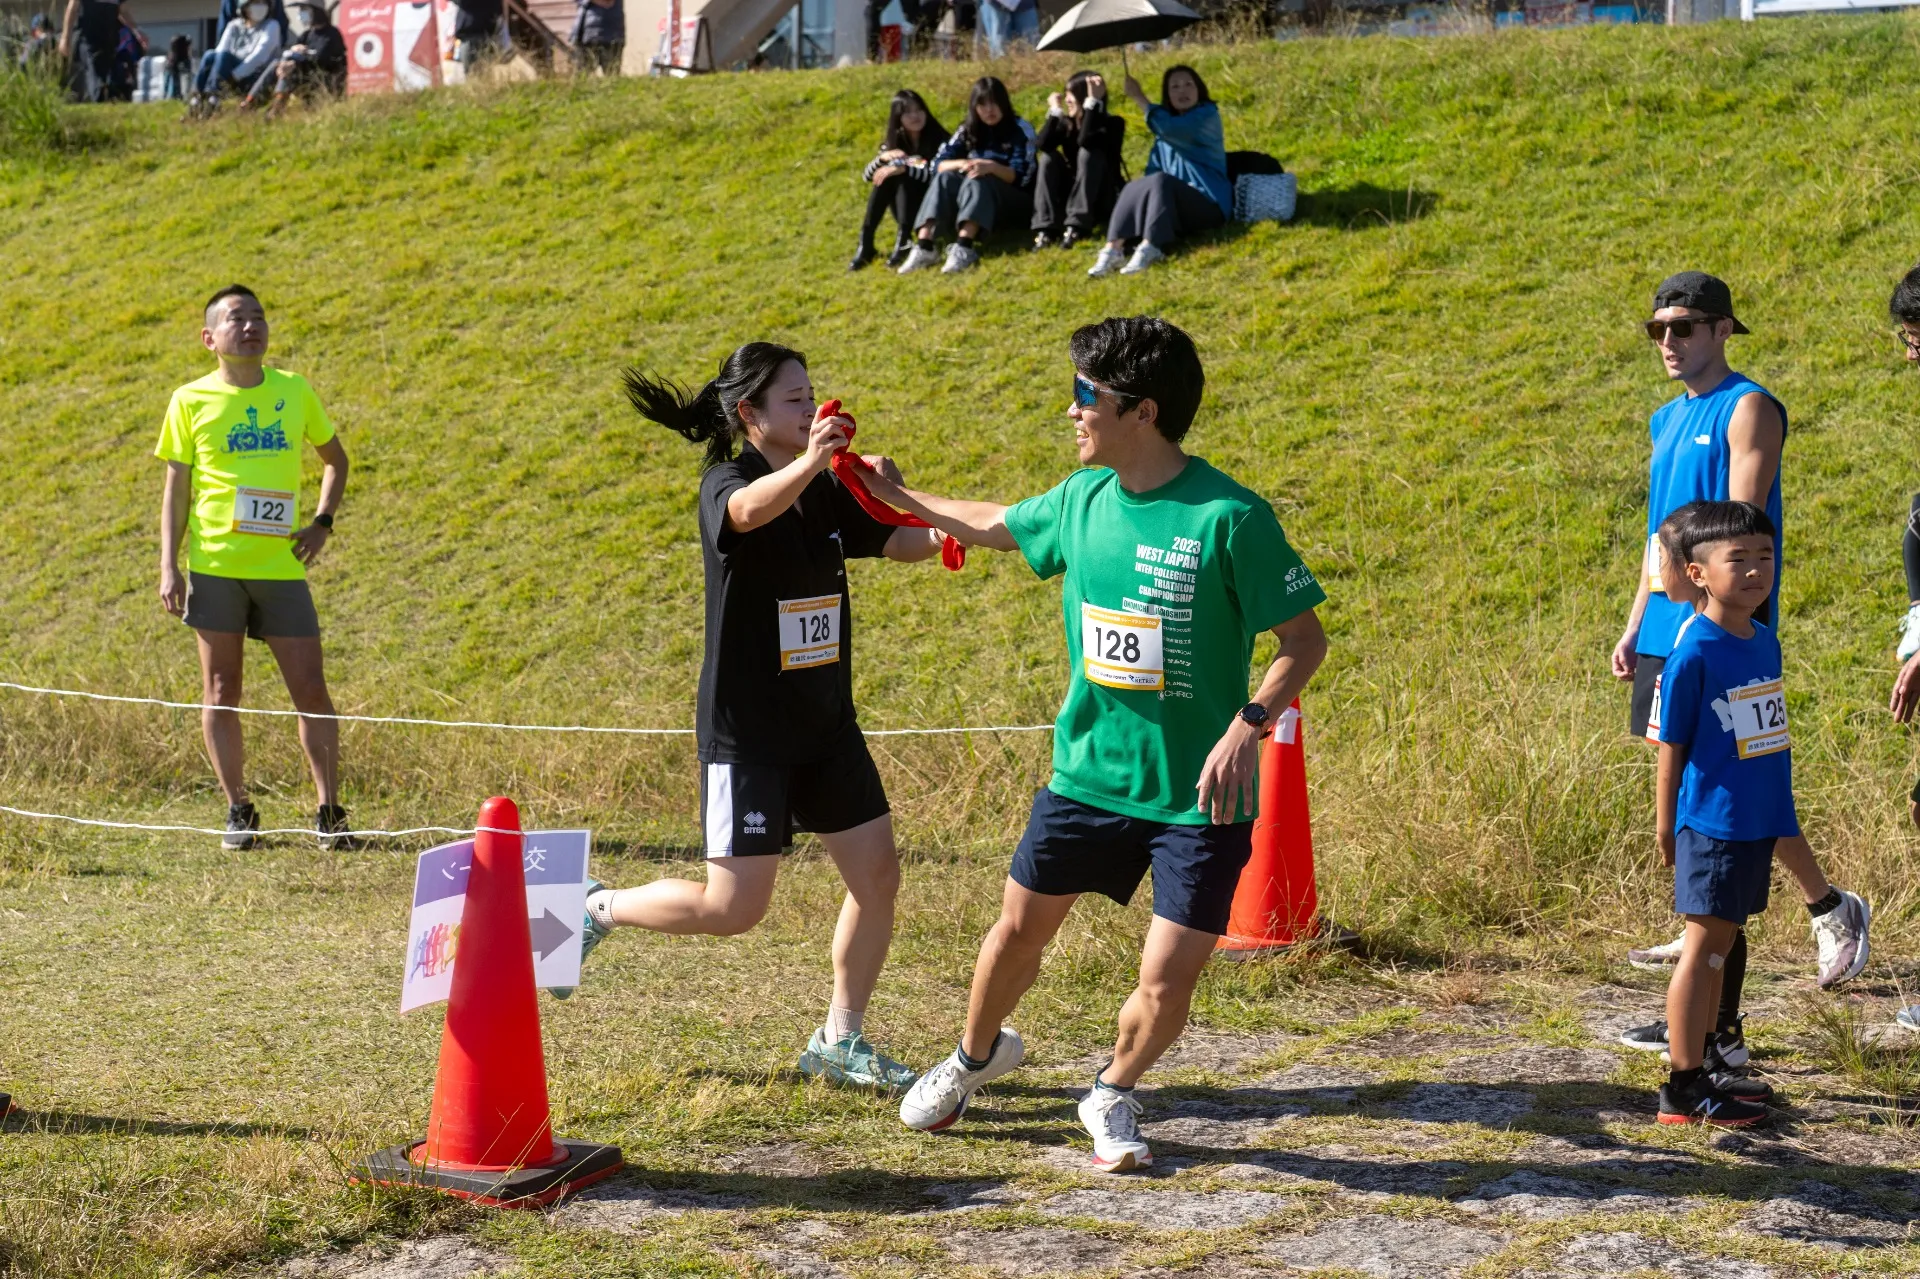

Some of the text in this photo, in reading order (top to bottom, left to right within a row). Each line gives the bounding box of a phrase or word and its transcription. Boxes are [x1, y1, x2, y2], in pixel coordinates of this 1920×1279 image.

[227, 430, 289, 453] KOBE
[252, 499, 285, 522] 122
[1136, 544, 1199, 570] WEST JAPAN
[1172, 536, 1202, 555] 2023
[1135, 562, 1197, 584] INTER COLLEGIATE
[1138, 584, 1194, 603] CHAMPIONSHIP
[1154, 577, 1195, 593] TRIATHLON
[799, 613, 830, 645] 128
[1095, 626, 1141, 664] 128
[1751, 696, 1786, 731] 125
[744, 826, 766, 834] errea
